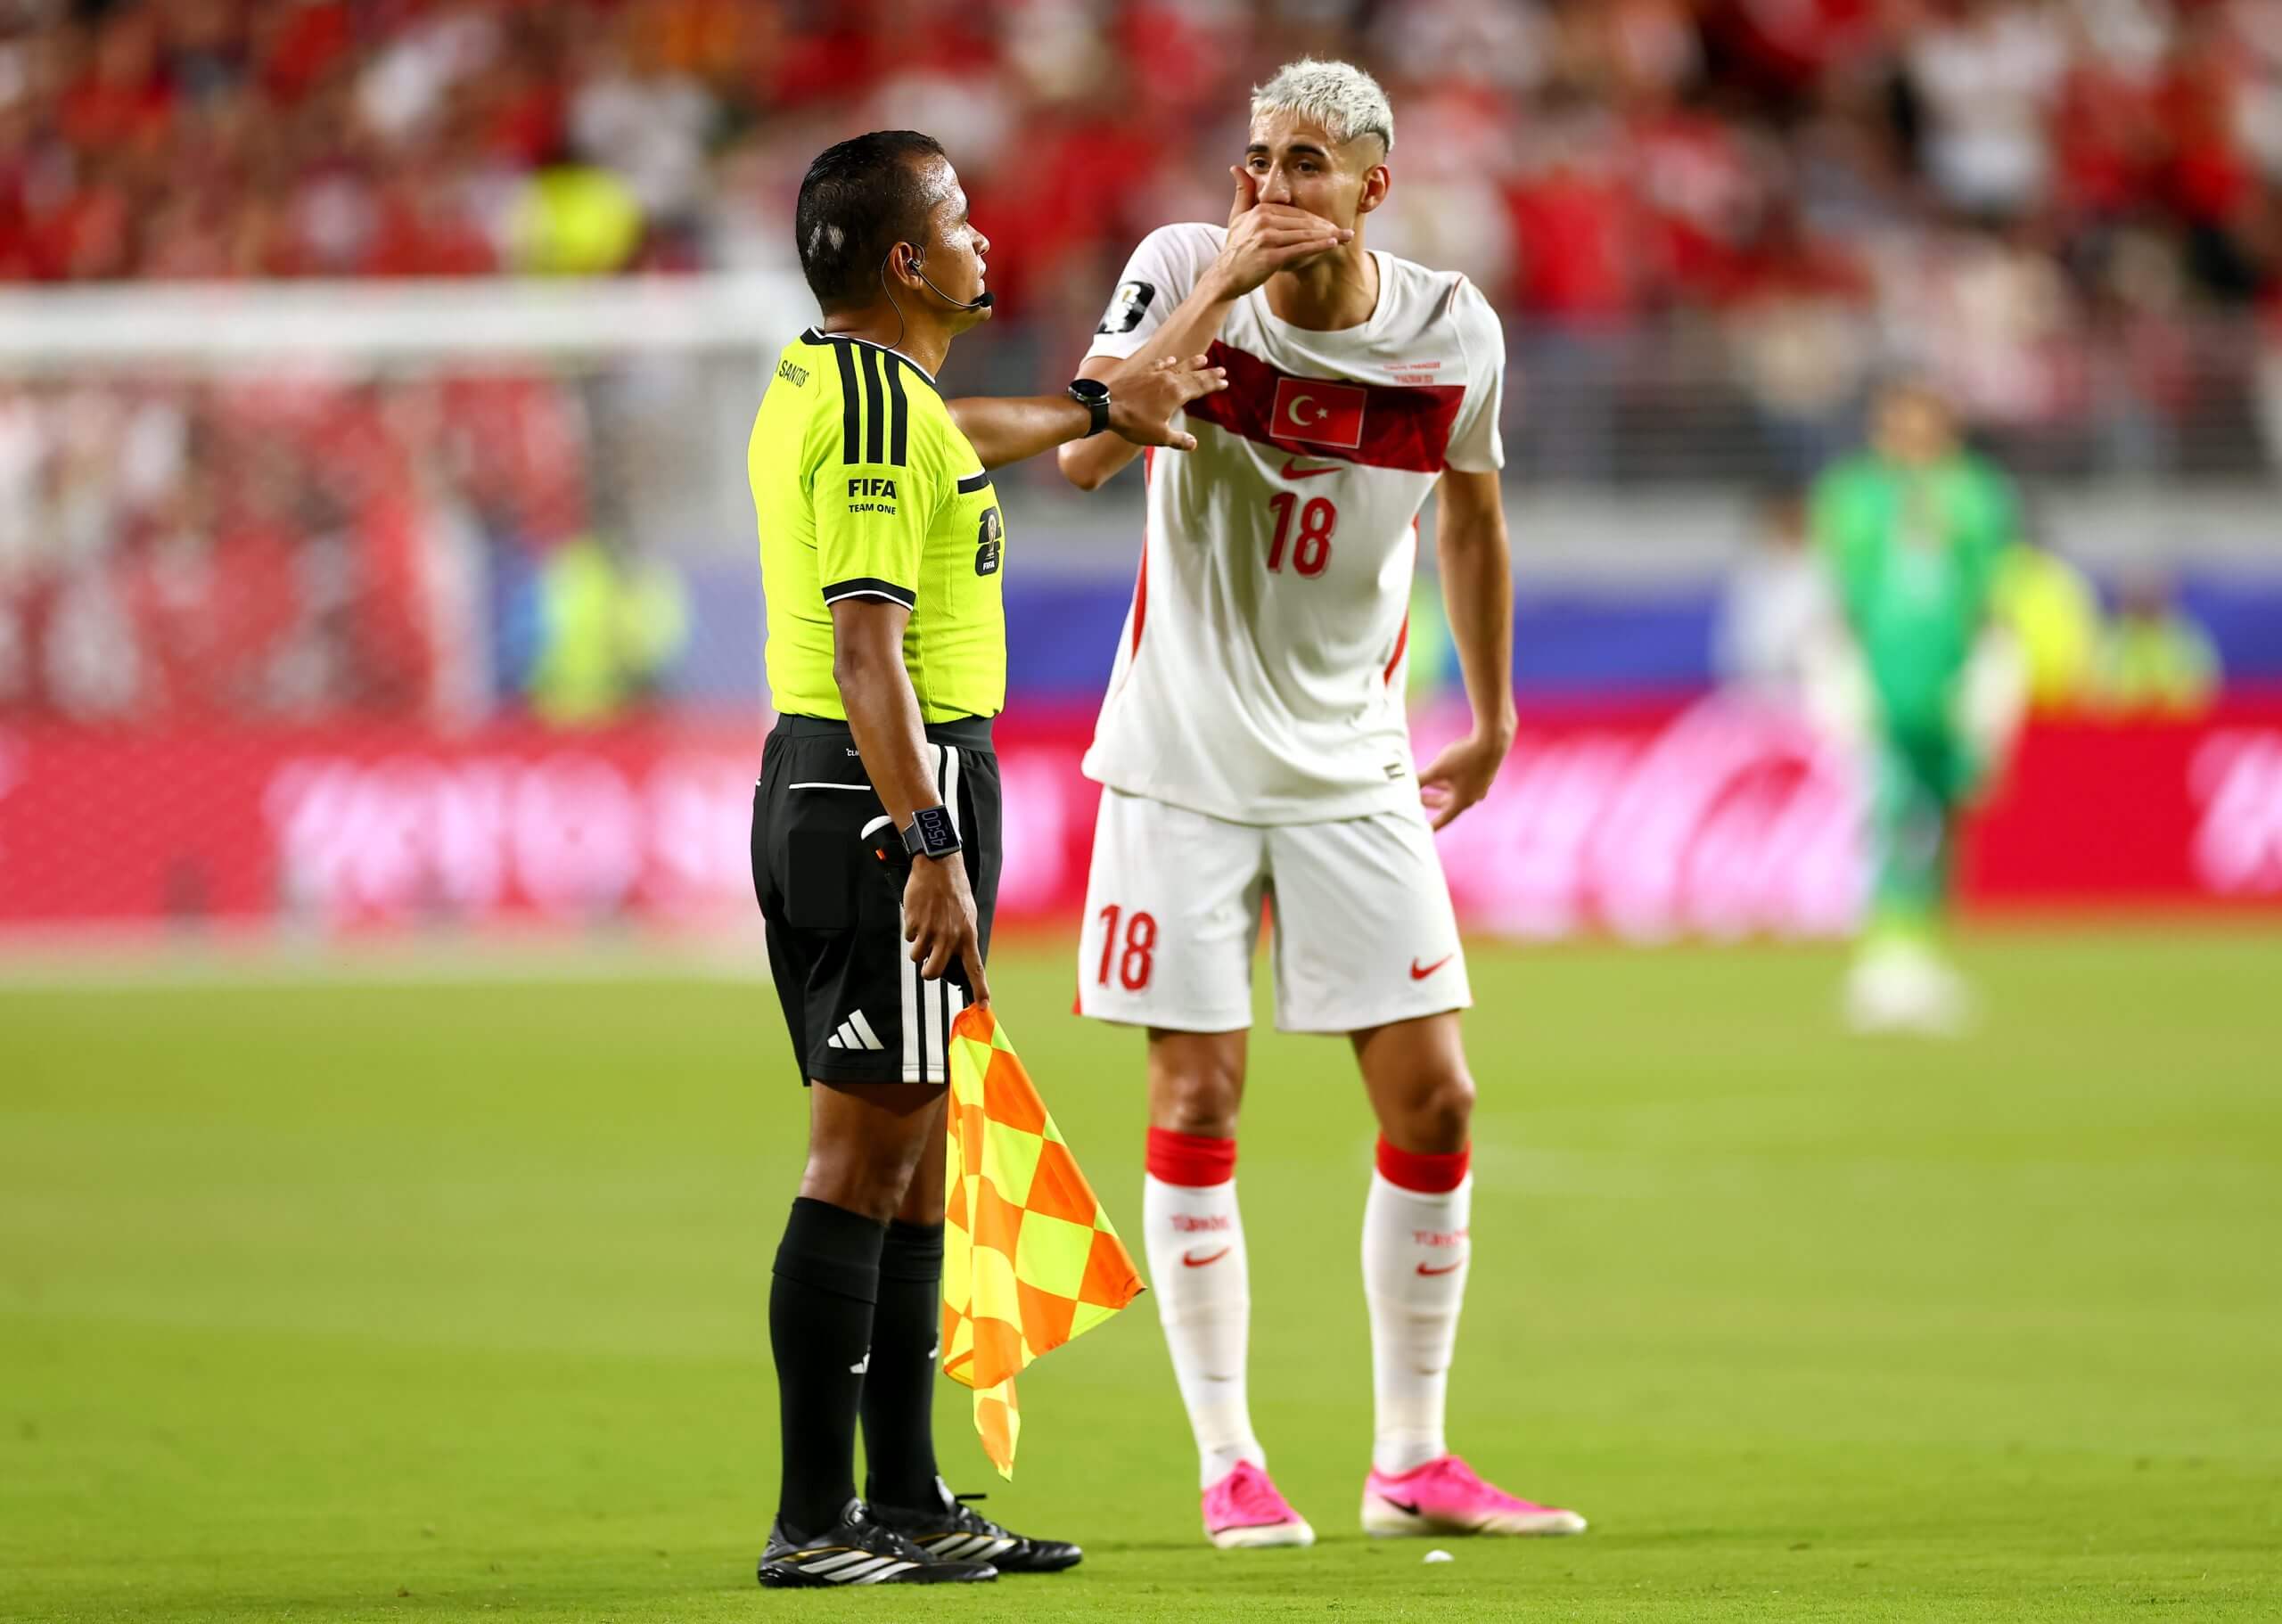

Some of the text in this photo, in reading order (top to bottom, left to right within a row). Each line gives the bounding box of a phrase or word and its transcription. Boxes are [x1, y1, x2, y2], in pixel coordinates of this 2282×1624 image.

[849, 479, 897, 499] FIFA
[849, 504, 896, 515] TEAM ONE
[1268, 491, 1337, 578] 18
[982, 561, 995, 570] FIFA
[922, 810, 948, 846] 45:00
[1097, 904, 1158, 991] 18
